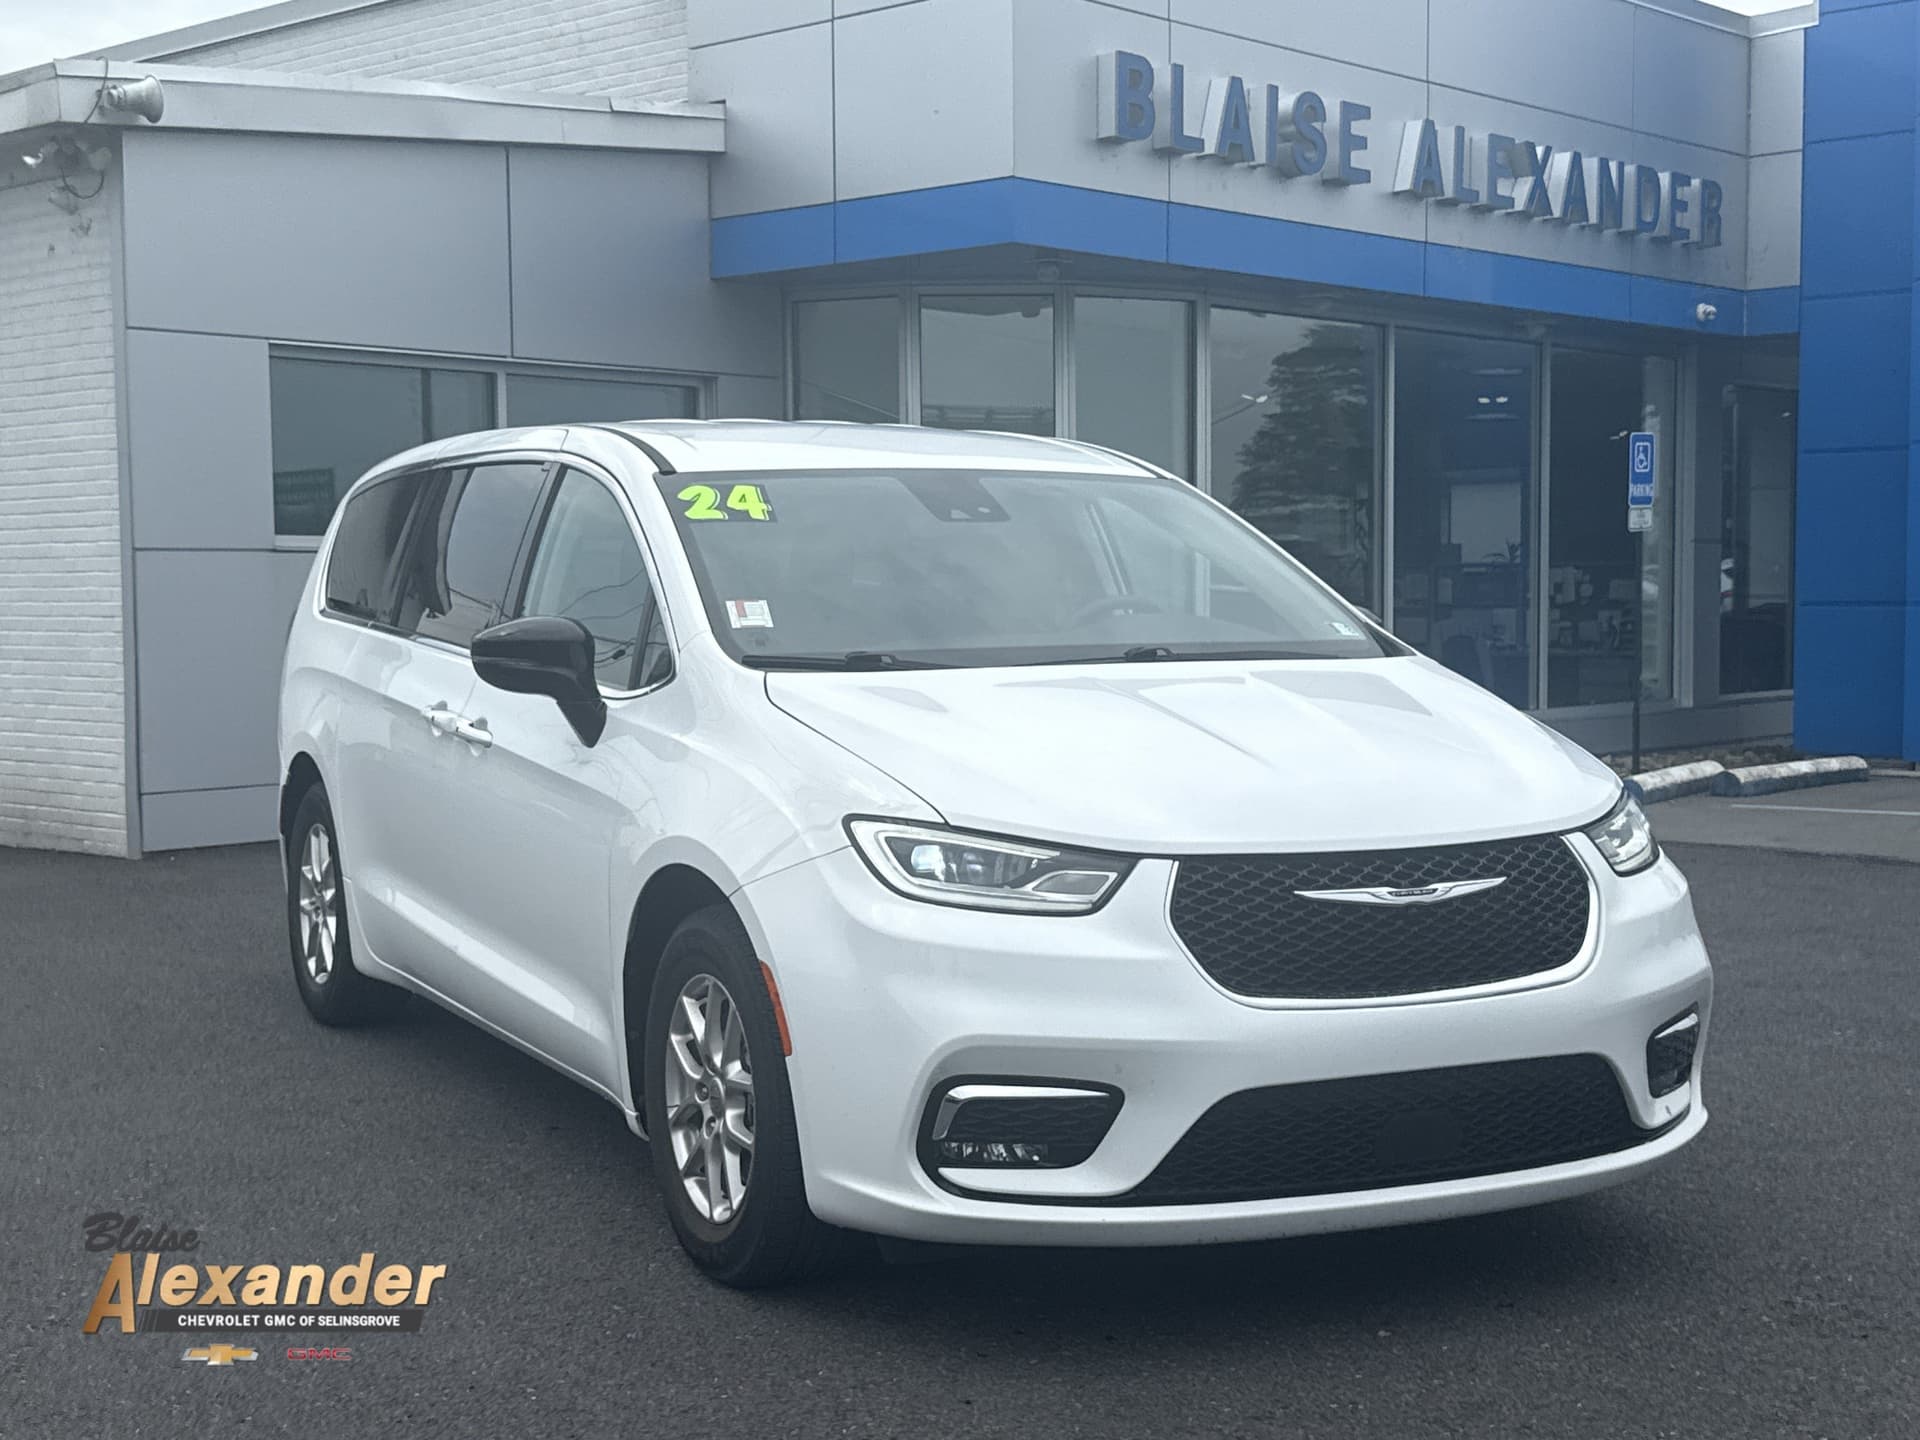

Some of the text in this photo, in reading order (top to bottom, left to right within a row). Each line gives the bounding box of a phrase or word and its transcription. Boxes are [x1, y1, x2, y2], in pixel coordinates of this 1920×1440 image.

[1097, 50, 1724, 249] BLAISE ALEXANDER
[677, 484, 772, 521] 24
